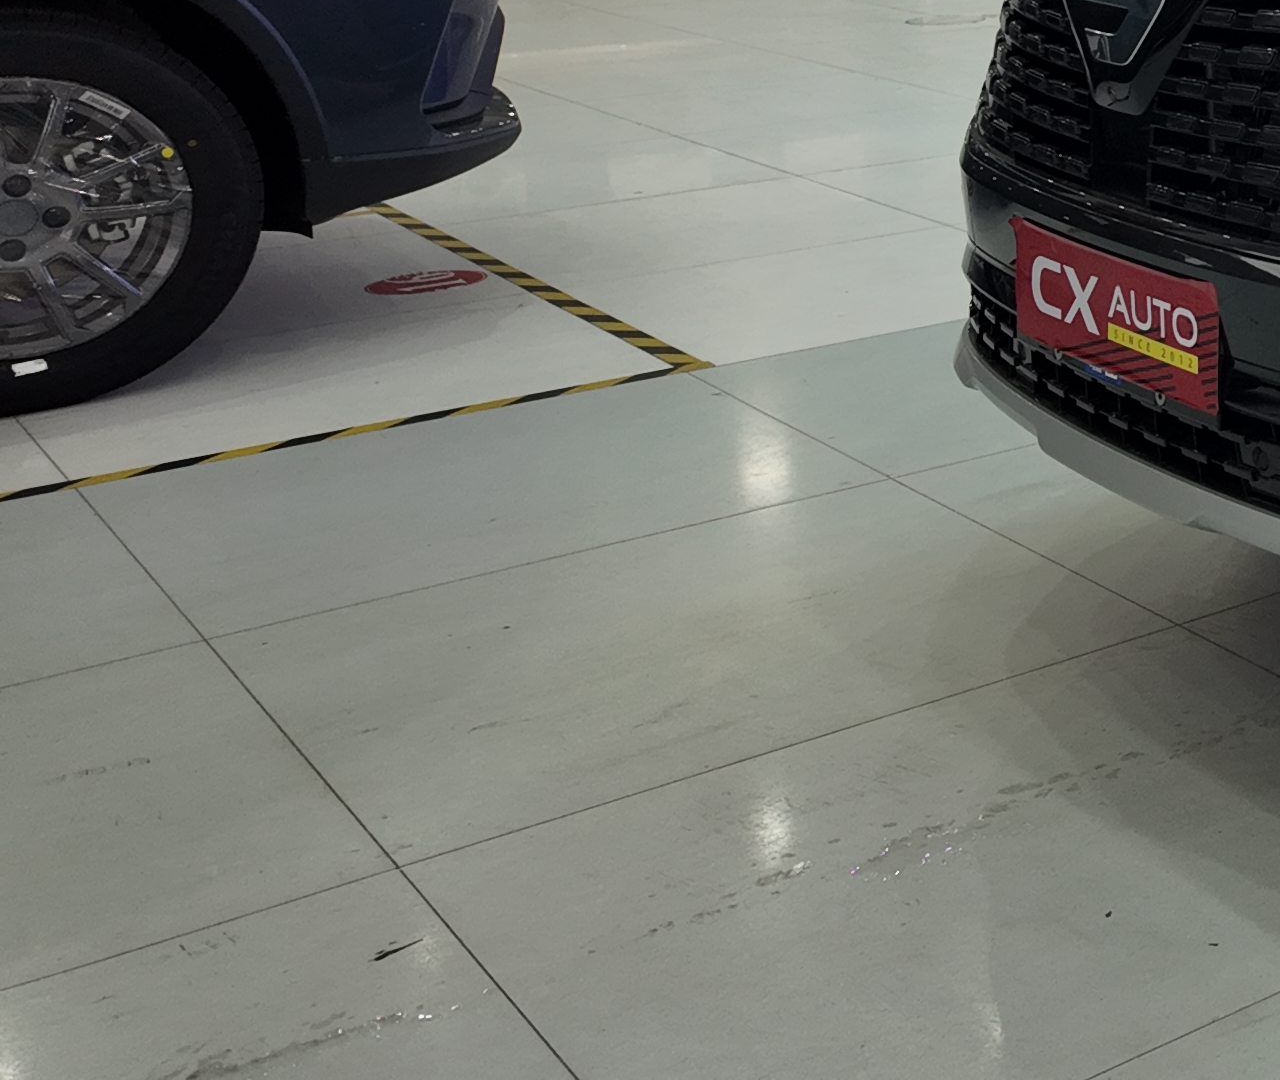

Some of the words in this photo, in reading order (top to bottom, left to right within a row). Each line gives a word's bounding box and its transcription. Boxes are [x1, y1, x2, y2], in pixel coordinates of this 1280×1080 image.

[1031, 255, 1100, 336] CX
[1107, 285, 1199, 348] AUTO
[1113, 328, 1152, 353] SINCE
[1161, 349, 1194, 370] 2012
